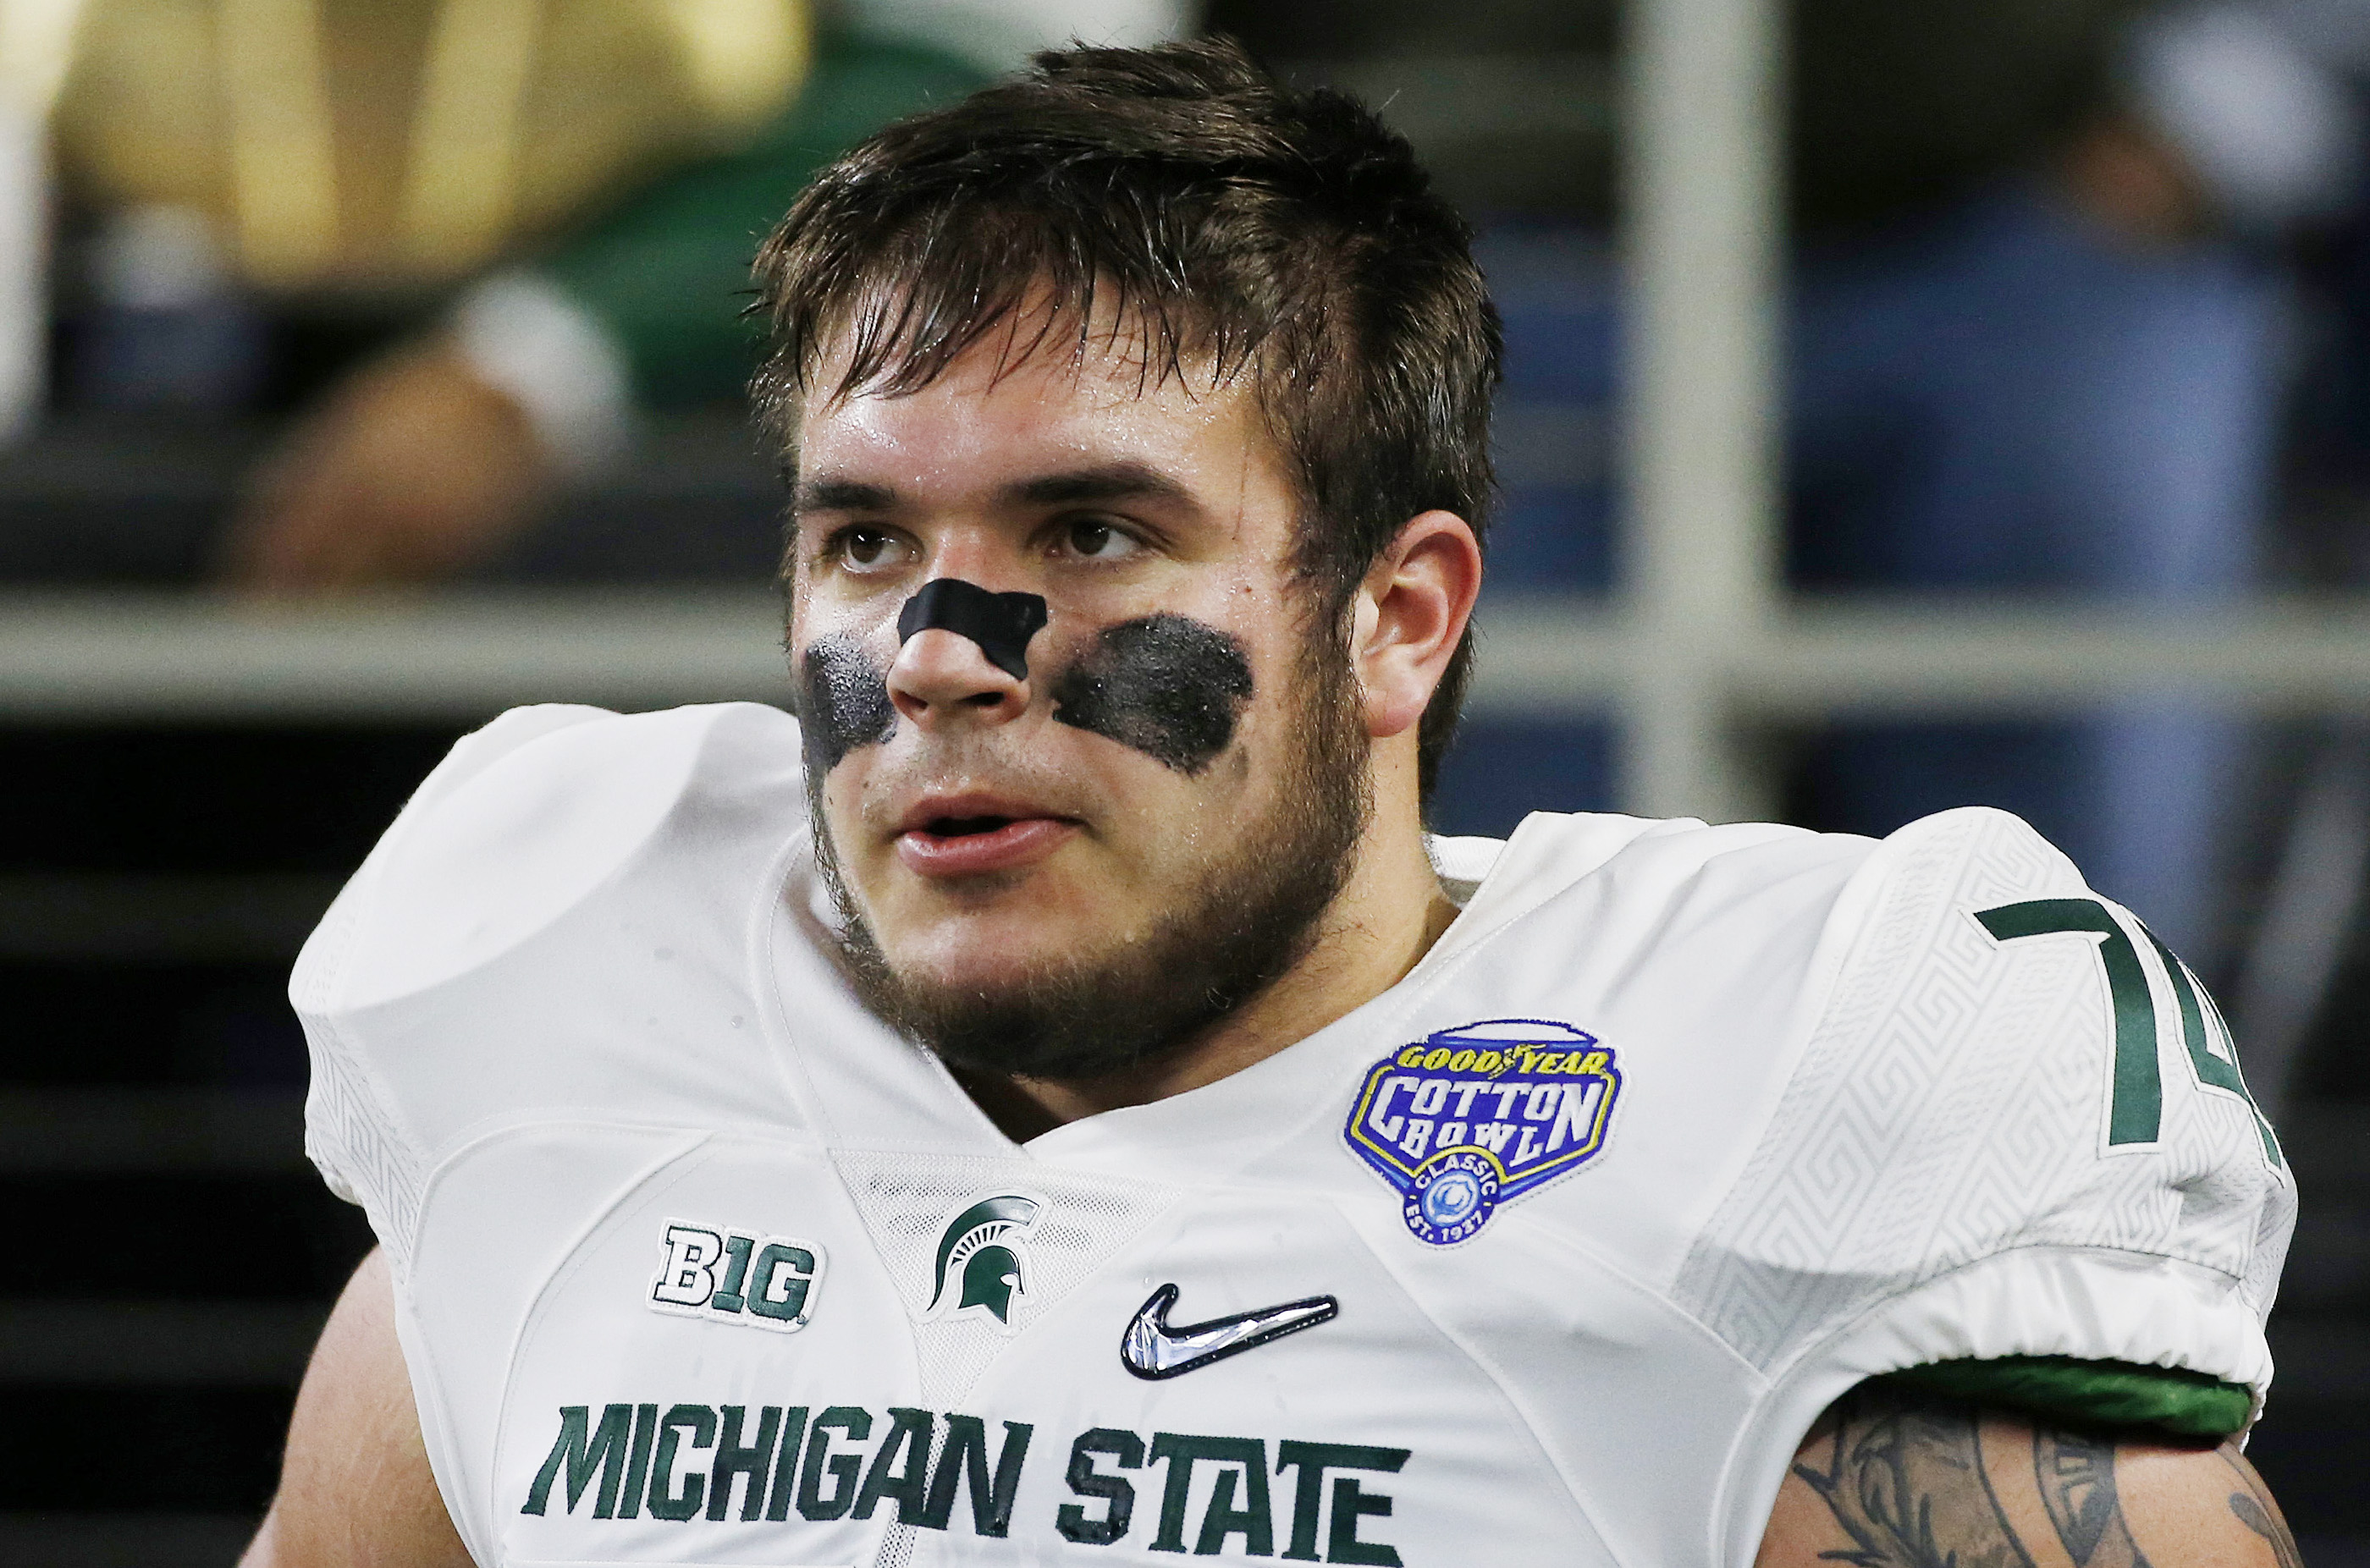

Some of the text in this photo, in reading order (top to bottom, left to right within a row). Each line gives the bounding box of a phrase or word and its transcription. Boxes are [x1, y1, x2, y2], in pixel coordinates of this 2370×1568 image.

[1397, 1046, 1609, 1076] GOODYEAR
[1369, 1076, 1603, 1153] COTTON
[1399, 1119, 1544, 1167] BOWL
[1415, 1155, 1497, 1196] CLASSIC
[1406, 1204, 1483, 1241] EST. 1937
[520, 1404, 1412, 1567] MICHIGAN STATE
